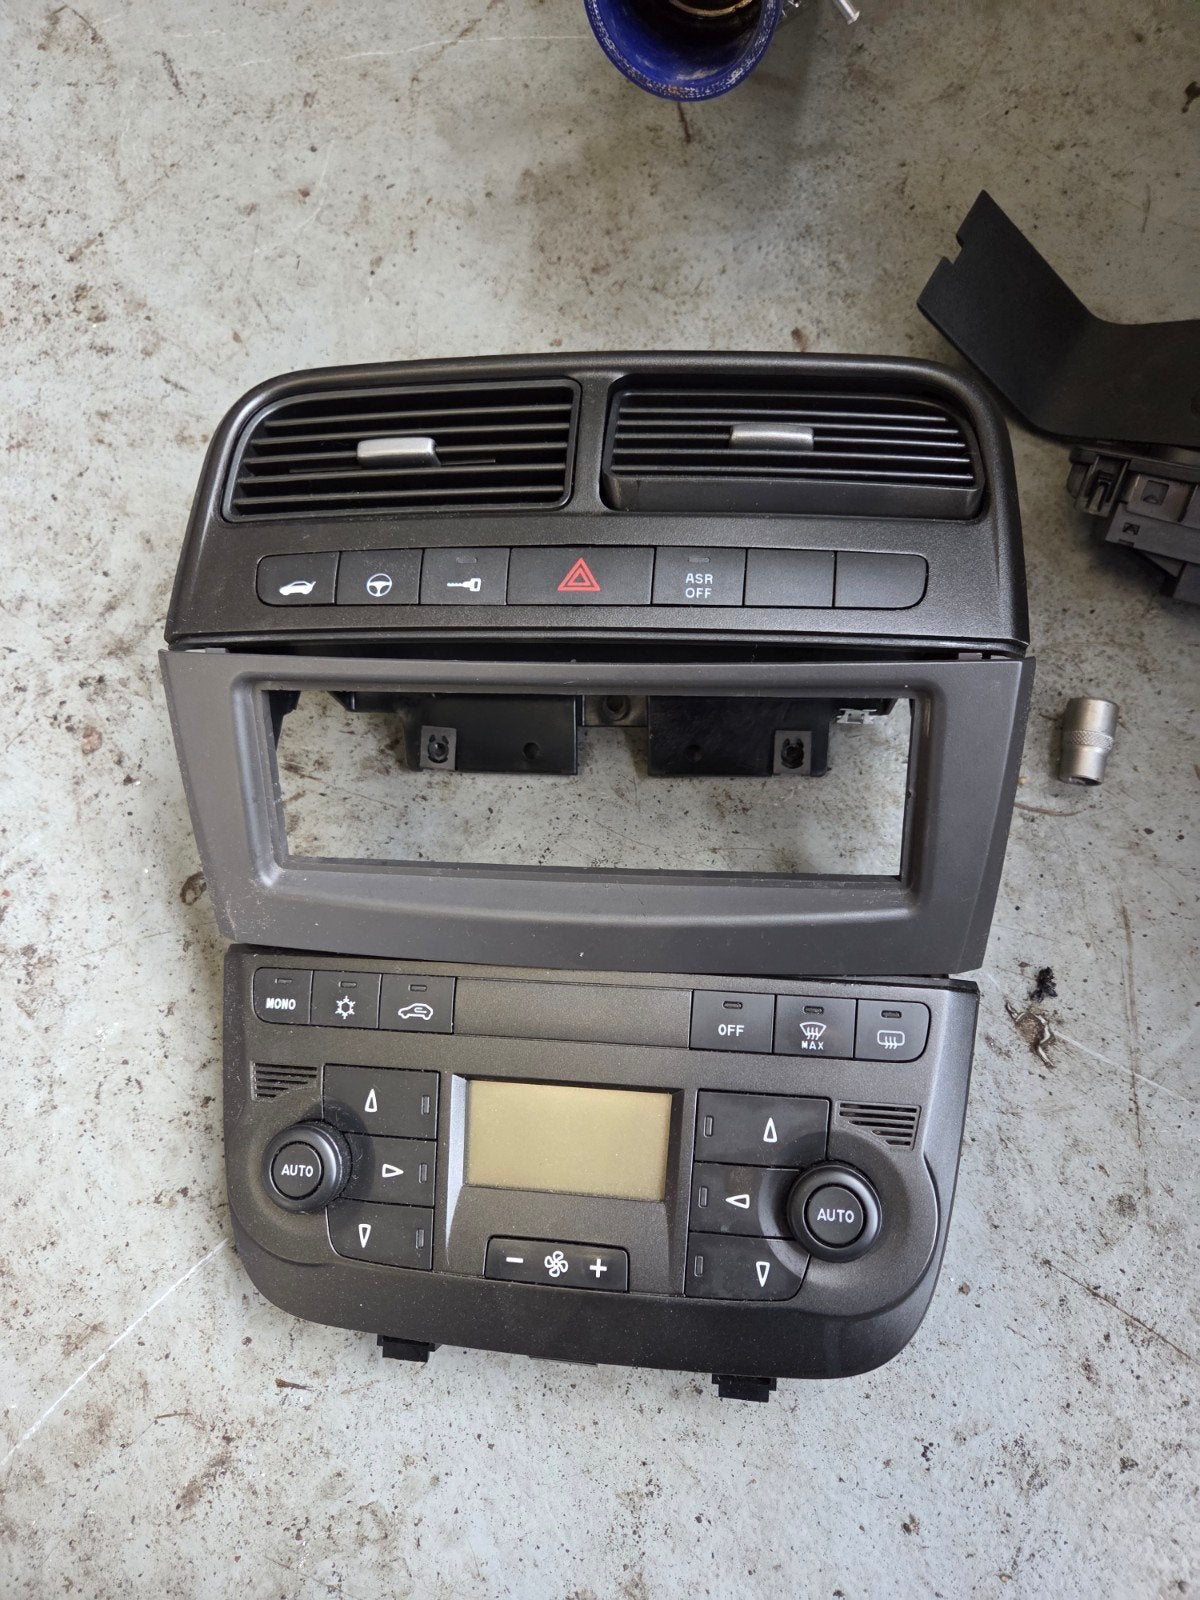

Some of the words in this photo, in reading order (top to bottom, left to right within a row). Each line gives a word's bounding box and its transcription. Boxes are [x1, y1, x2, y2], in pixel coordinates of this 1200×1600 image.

[685, 573, 713, 585] ASR
[685, 587, 712, 599] OFF
[265, 997, 297, 1010] MONO
[717, 1024, 745, 1037] OFF
[801, 1041, 824, 1051] MAX
[281, 1164, 313, 1177] AUTO
[816, 1208, 855, 1223] AUTO
